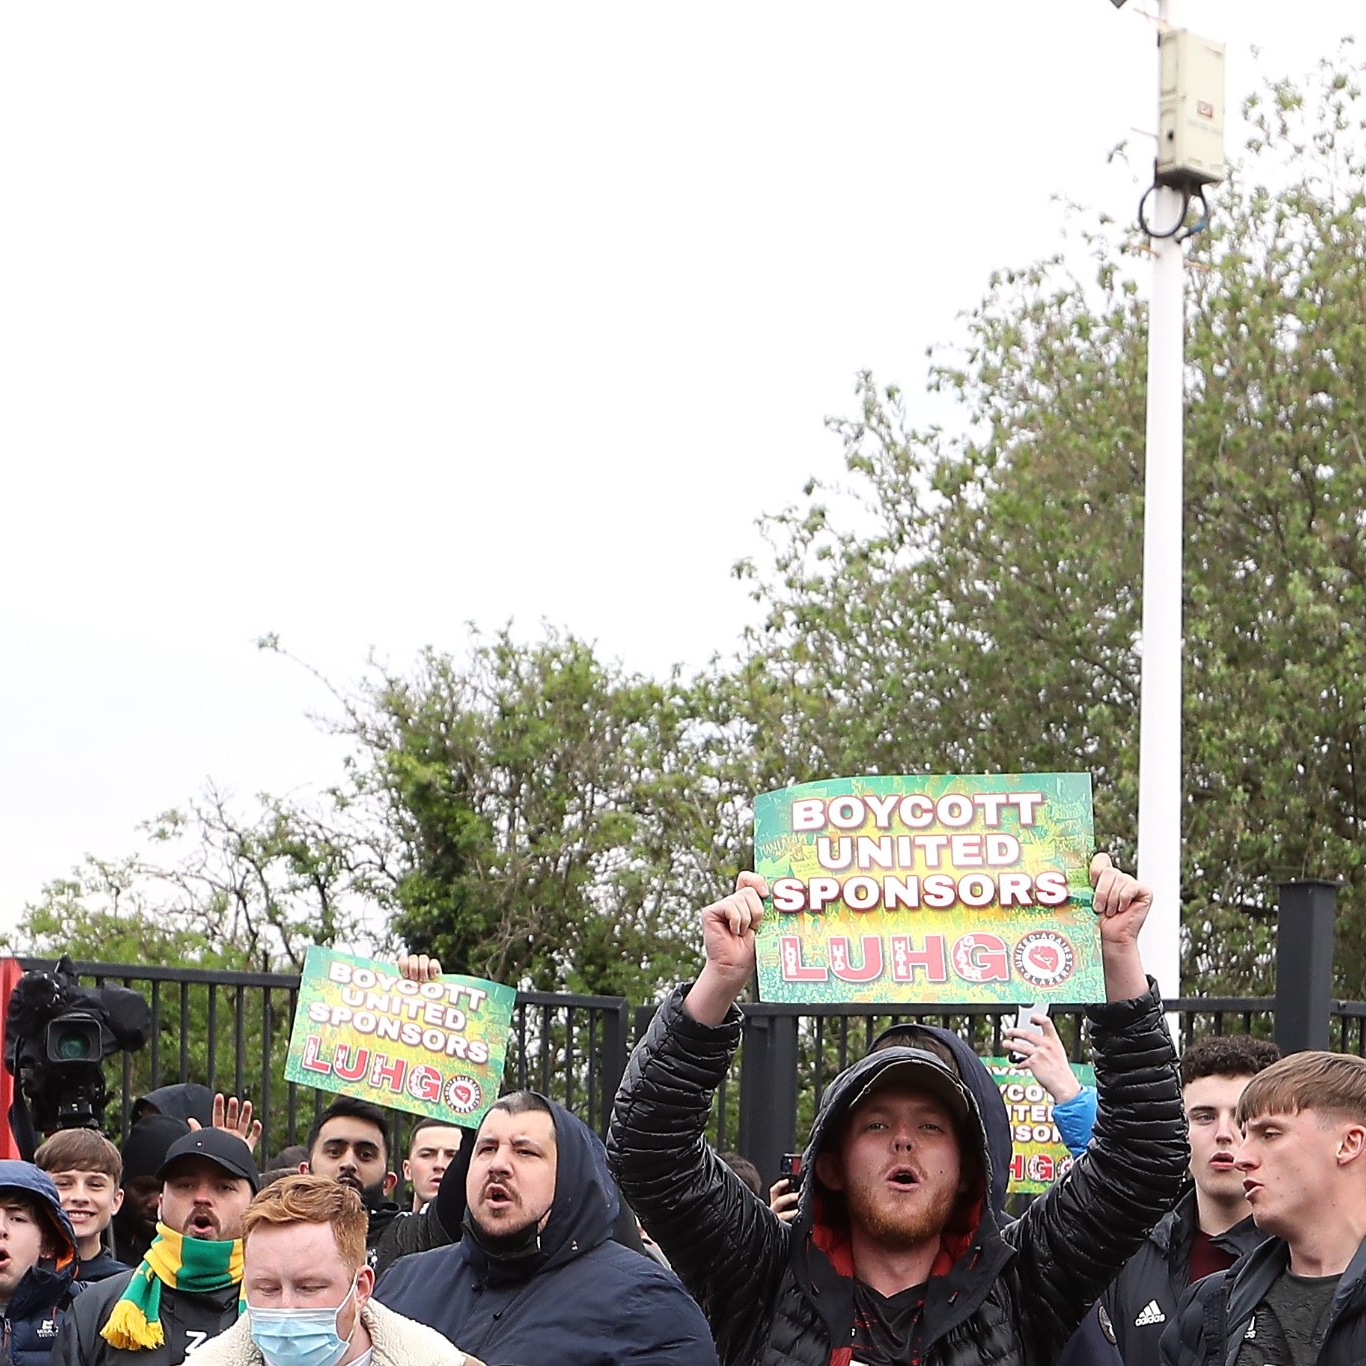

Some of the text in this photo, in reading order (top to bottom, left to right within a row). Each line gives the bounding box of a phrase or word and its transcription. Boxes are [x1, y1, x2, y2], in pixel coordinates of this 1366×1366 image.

[791, 792, 1043, 832] BOYCOTT
[816, 833, 1021, 870] UNITED
[773, 871, 1069, 912] SPONSORS
[779, 932, 1011, 983] LUHG
[328, 960, 485, 1011] BOYCOTT
[341, 986, 467, 1031] UNITED
[308, 1001, 489, 1064] SPONSORS
[302, 1034, 443, 1103] LUHG
[1135, 1313, 1166, 1327] adidas
